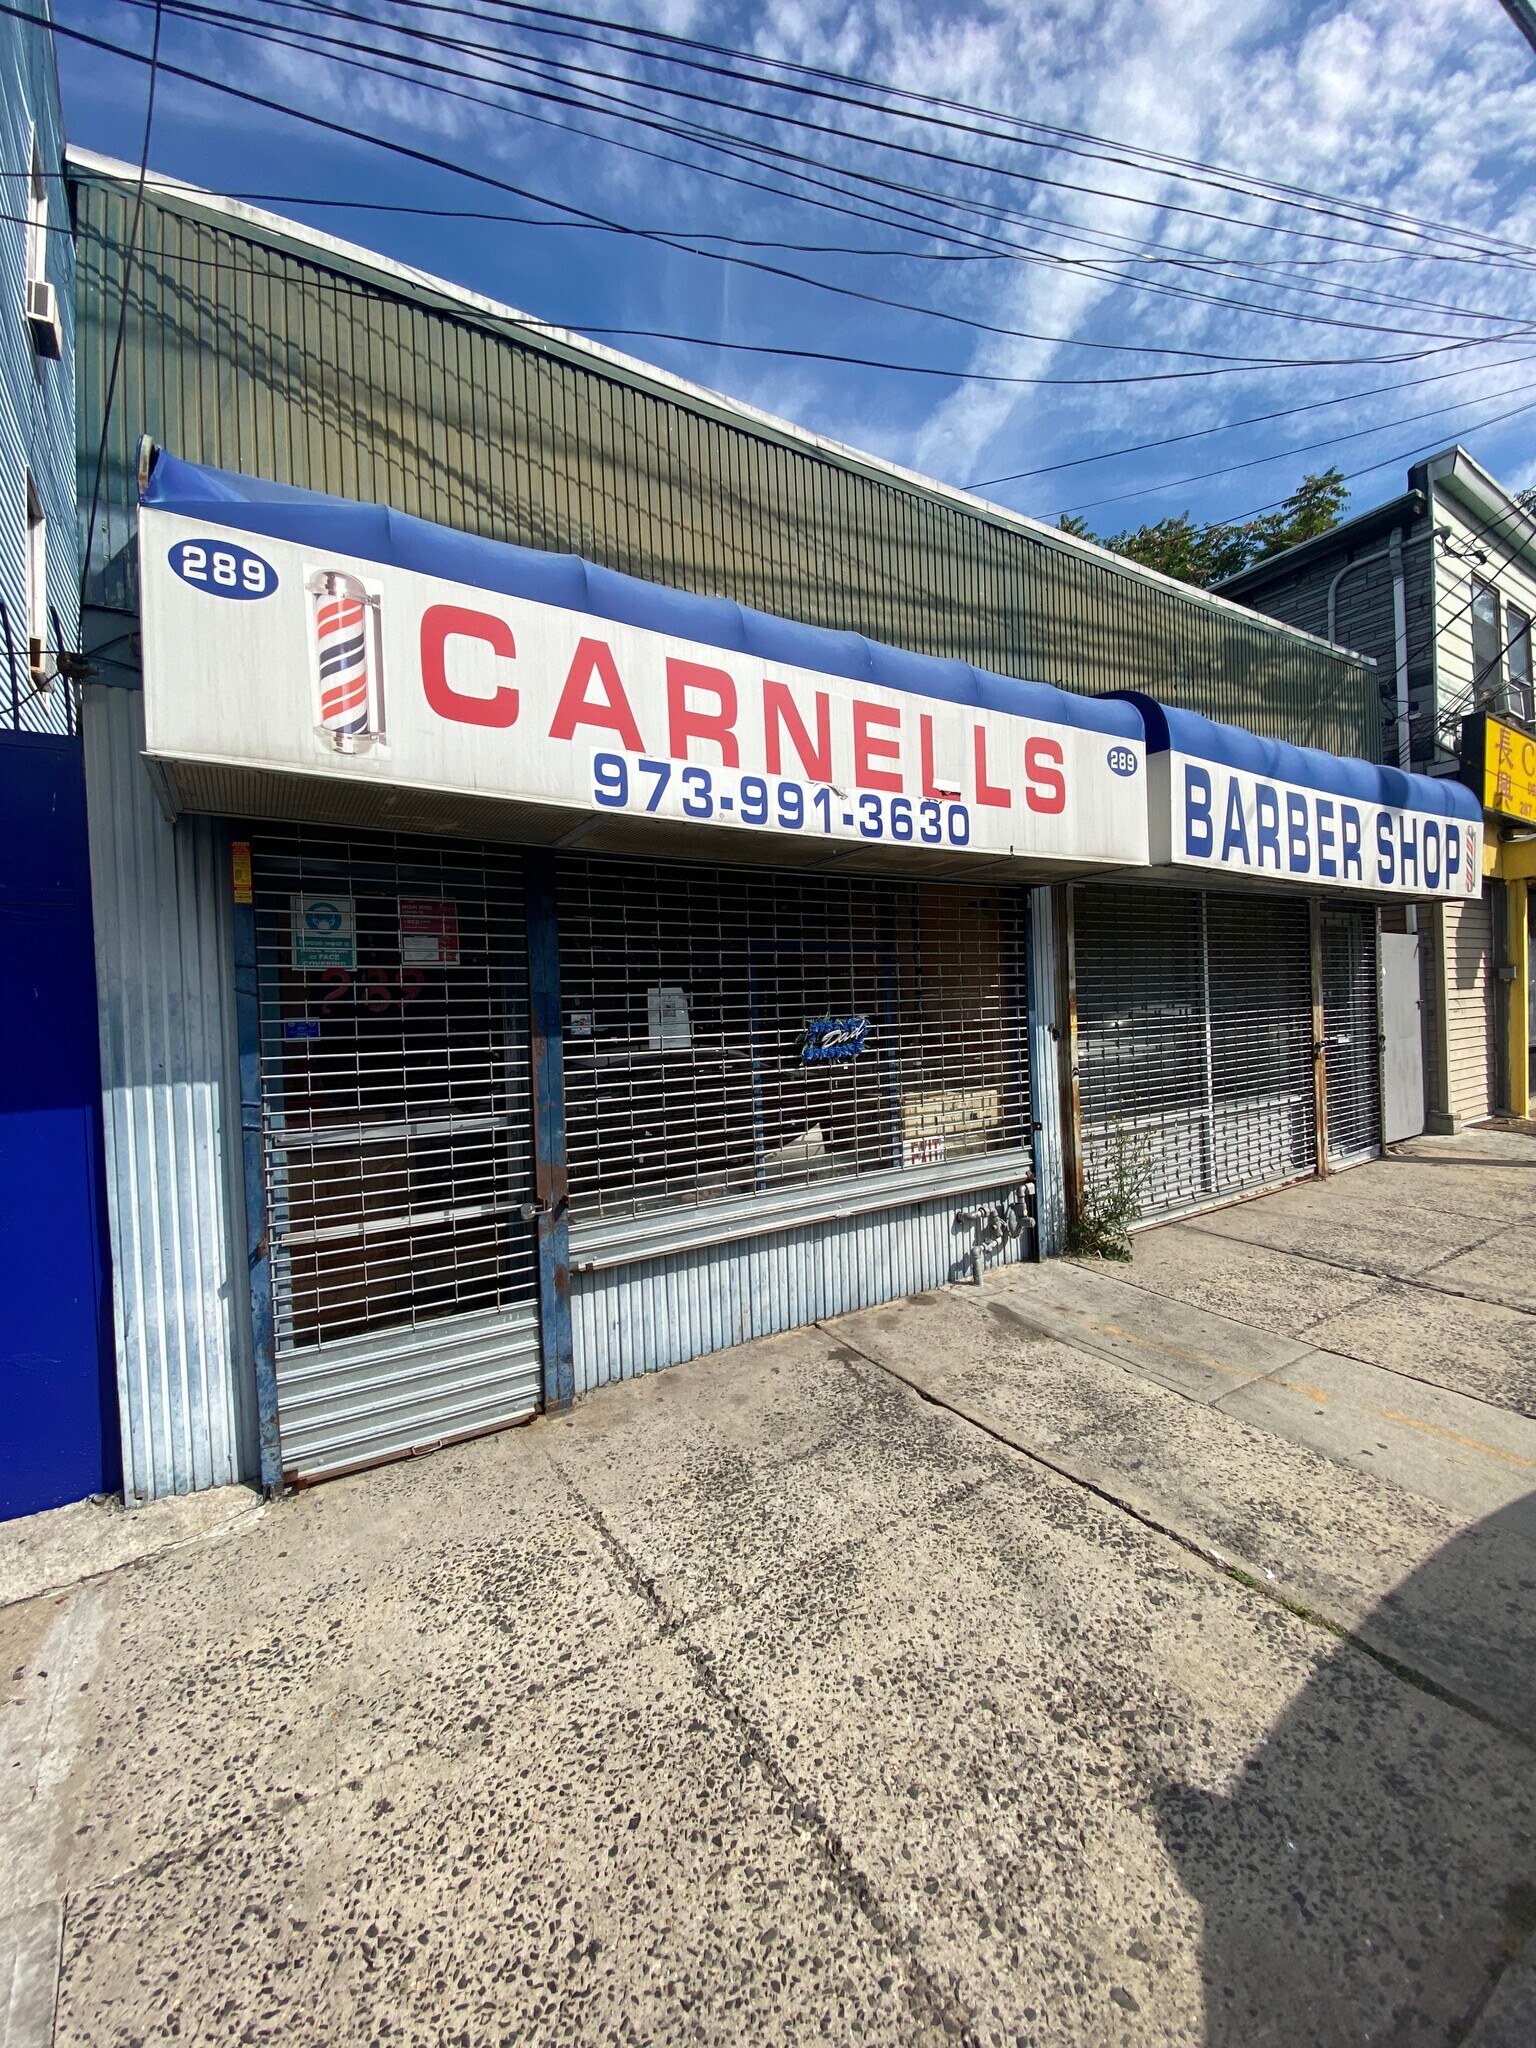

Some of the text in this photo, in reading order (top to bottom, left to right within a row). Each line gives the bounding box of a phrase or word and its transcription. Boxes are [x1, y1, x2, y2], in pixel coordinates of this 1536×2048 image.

[182, 545, 267, 593] 289
[420, 604, 1066, 815] CARNELLS
[1110, 750, 1135, 772] 289
[593, 752, 970, 846] 973-991-3630
[1185, 763, 1461, 890] BARBER SHOP
[821, 1019, 865, 1050] Dad
